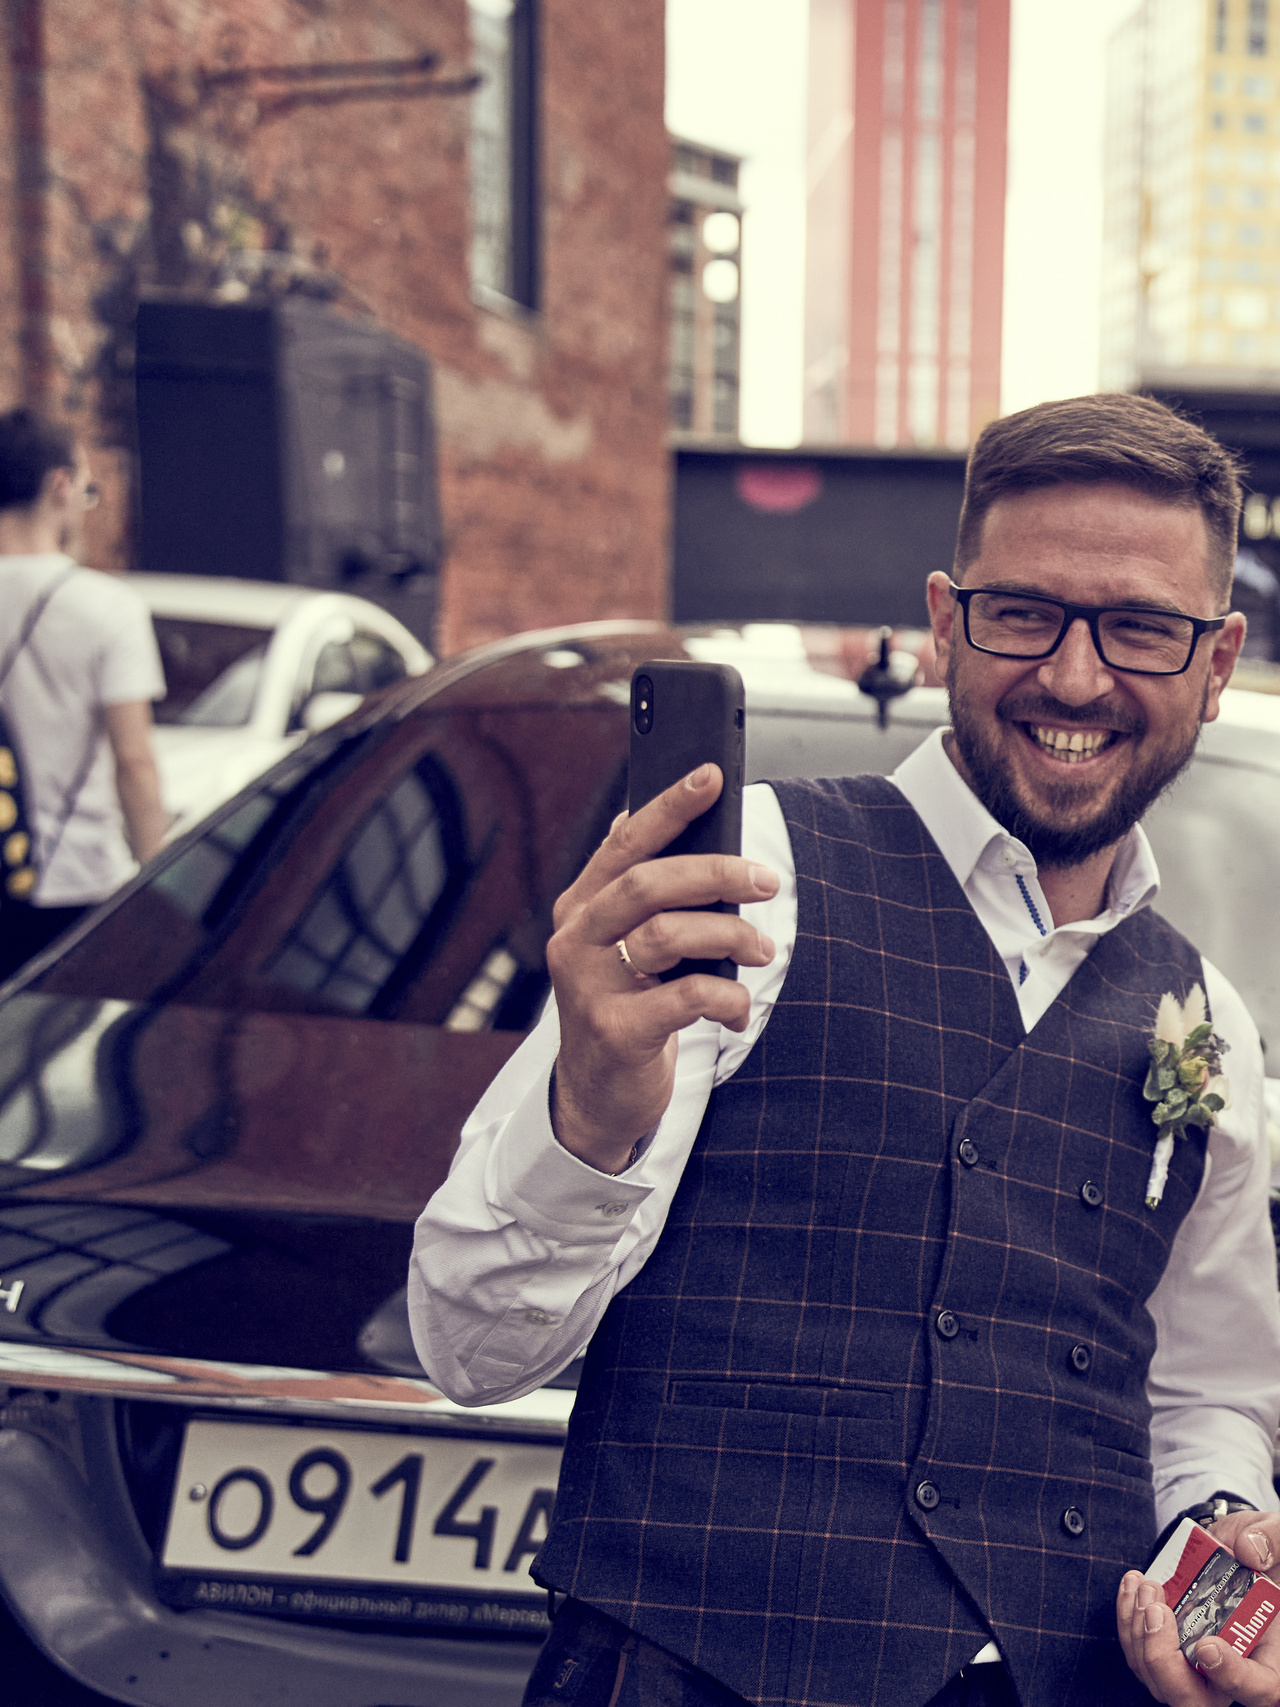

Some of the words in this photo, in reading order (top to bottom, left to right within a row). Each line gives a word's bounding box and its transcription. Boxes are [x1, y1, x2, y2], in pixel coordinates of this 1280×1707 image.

[194, 1581, 274, 1607] АВИЛОН
[289, 1590, 412, 1616] официальный
[414, 1601, 470, 1621] дилер
